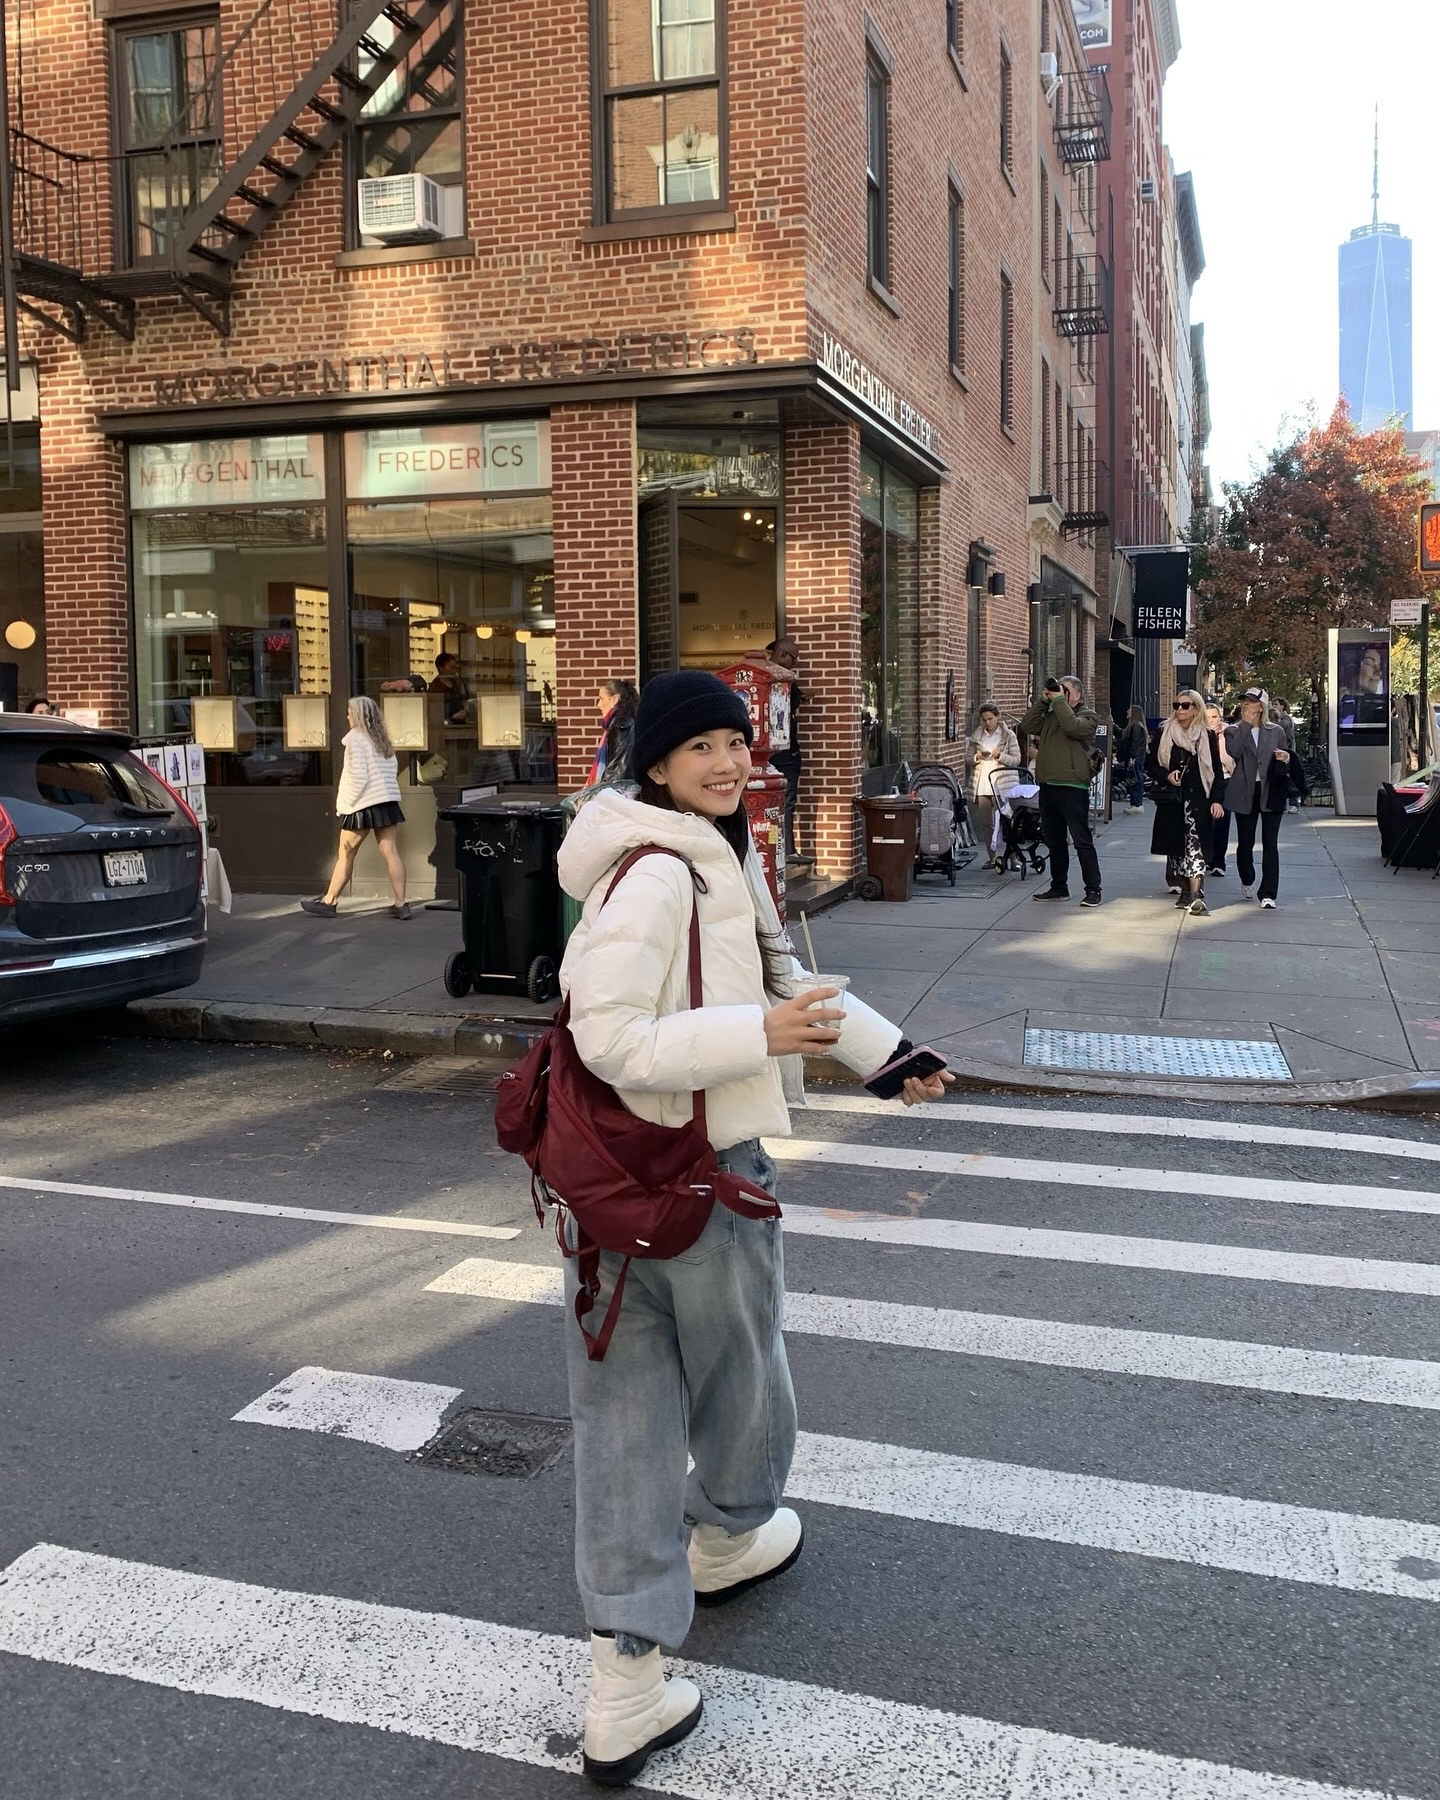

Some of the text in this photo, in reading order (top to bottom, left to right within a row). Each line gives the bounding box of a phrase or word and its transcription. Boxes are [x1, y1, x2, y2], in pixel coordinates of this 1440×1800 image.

[154, 326, 757, 405] MORGENTHAL FREDERICS
[823, 331, 941, 456] MORGENTHAL FREDERICS
[378, 445, 524, 474] FREDERICS
[1138, 607, 1182, 618] EILEEN
[1138, 619, 1181, 629] FISHER
[90, 829, 167, 840] VOLVO
[16, 864, 50, 874] XC90
